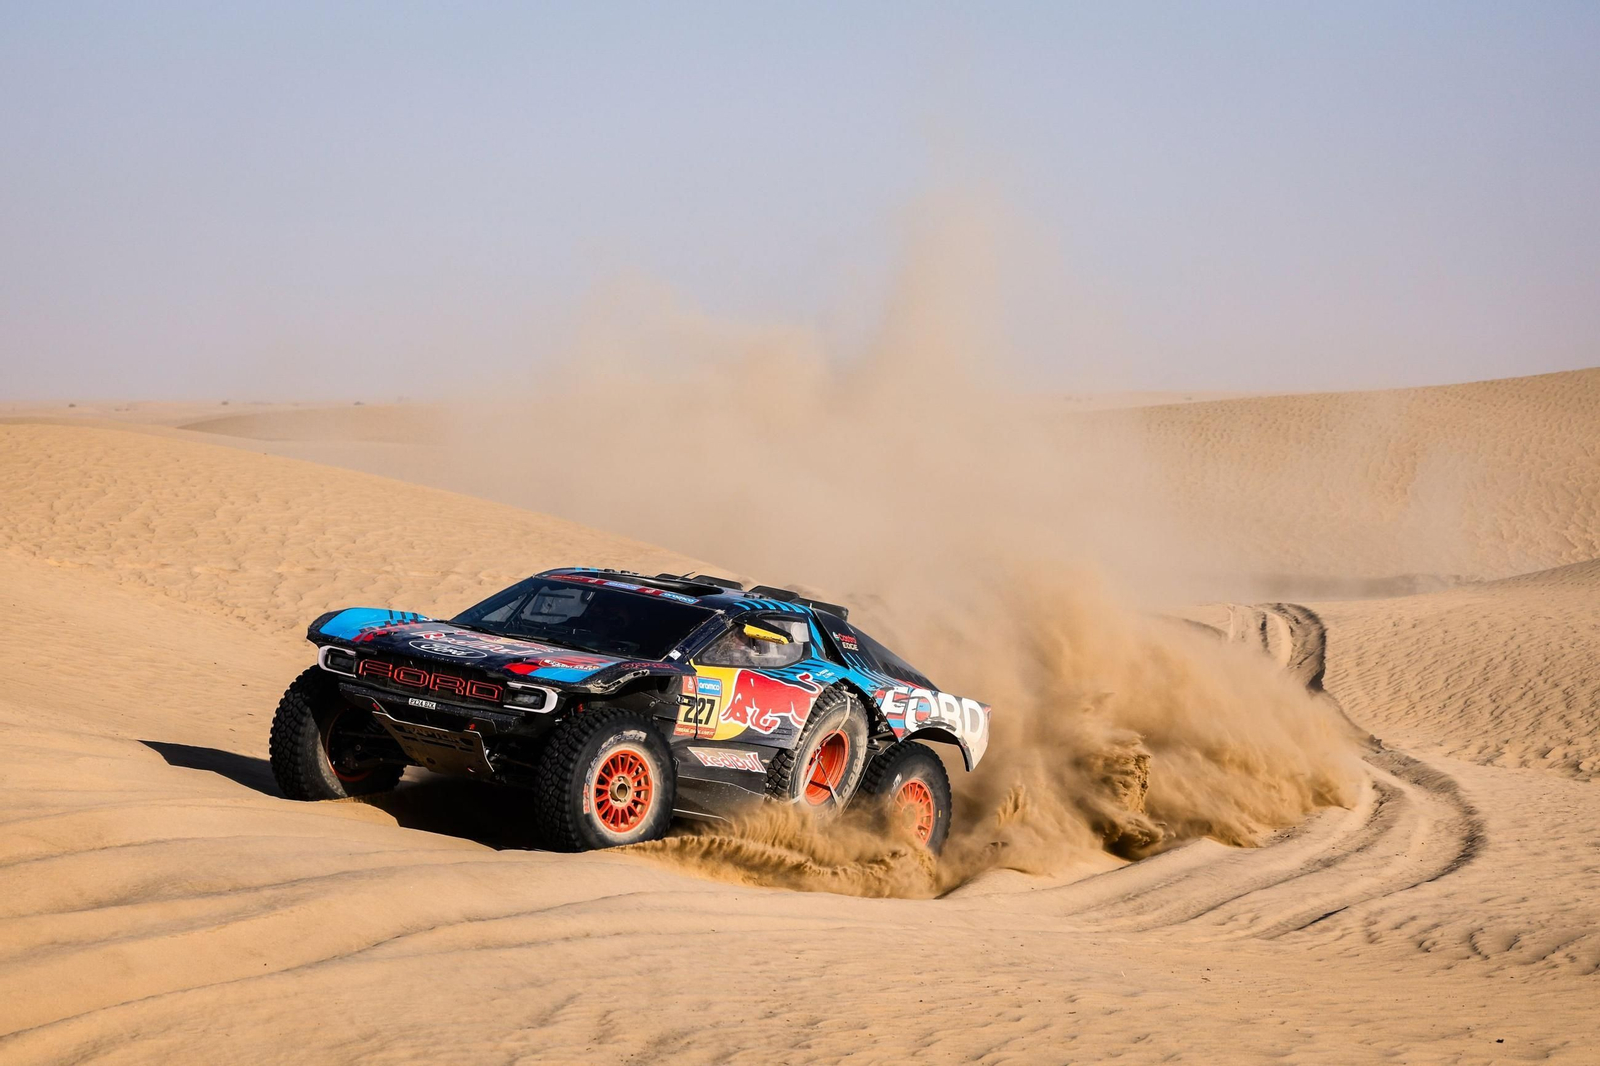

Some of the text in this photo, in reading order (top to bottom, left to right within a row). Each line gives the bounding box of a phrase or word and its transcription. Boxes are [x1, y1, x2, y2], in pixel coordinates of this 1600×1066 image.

[420, 643, 475, 657] Ford
[842, 642, 859, 651] EDGE
[358, 659, 503, 702] FORD
[699, 682, 720, 691] aramco
[683, 697, 716, 725] 227
[880, 686, 985, 744] FORD
